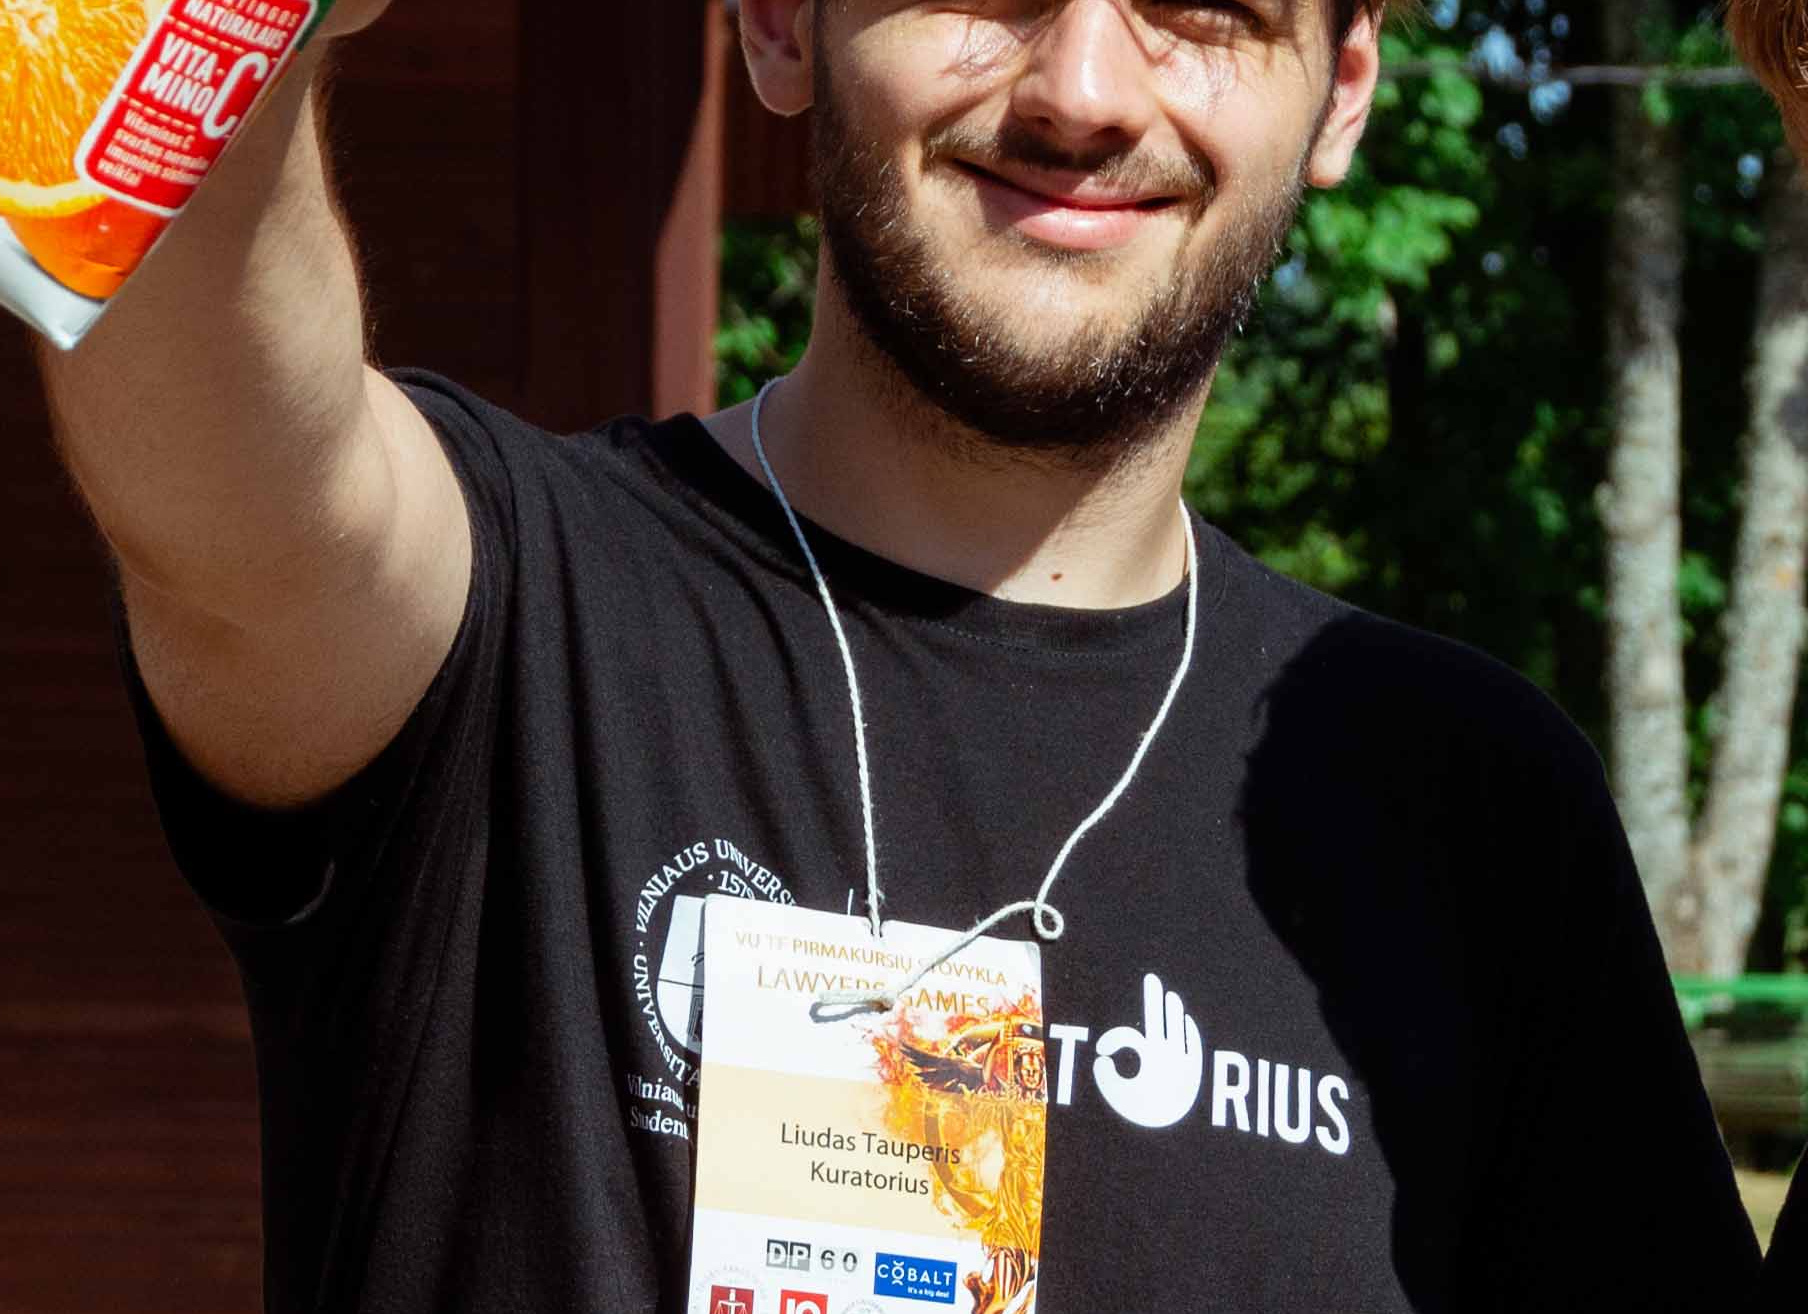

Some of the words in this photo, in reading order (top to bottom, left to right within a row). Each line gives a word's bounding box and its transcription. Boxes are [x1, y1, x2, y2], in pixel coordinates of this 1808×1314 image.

[636, 841, 710, 934] VILNIAUS
[793, 938, 912, 973] PIRMAKURSIŲ
[781, 1122, 856, 1151] Liudas
[862, 1132, 961, 1164] Tauperis
[810, 1160, 929, 1195] Kuratorius
[876, 1260, 953, 1286] COBALT
